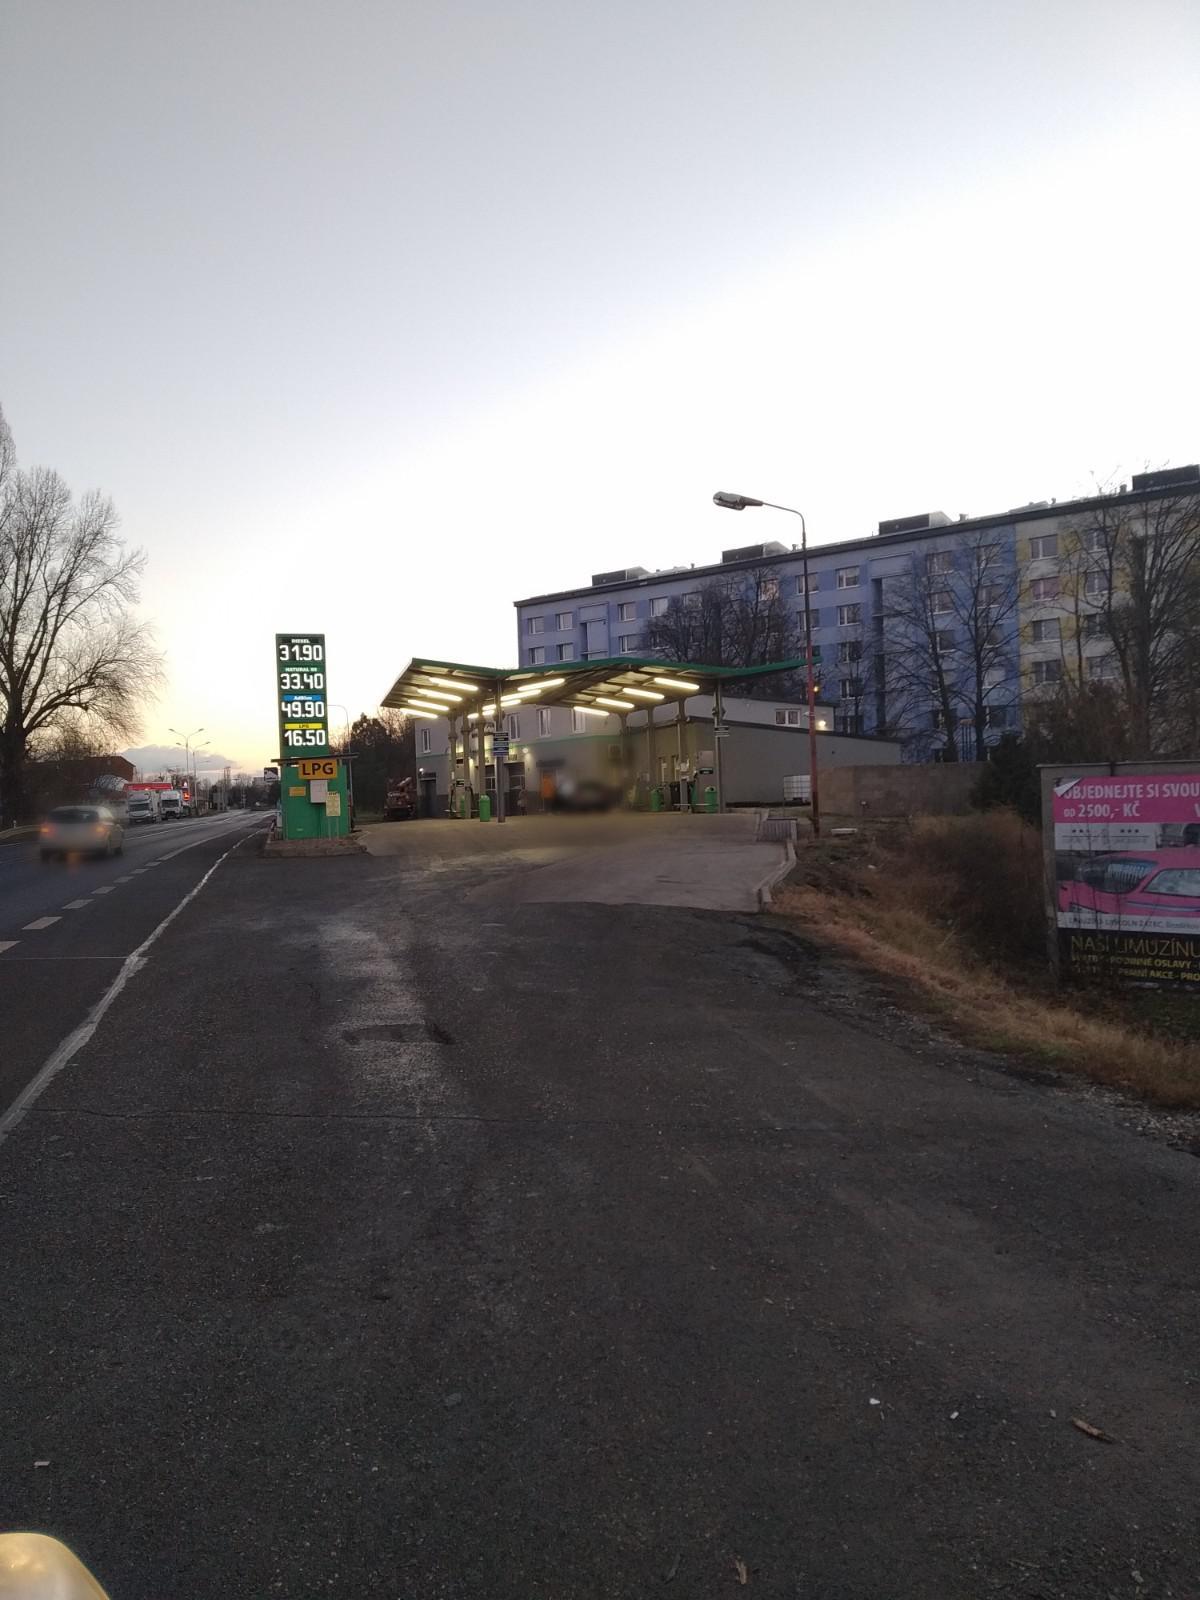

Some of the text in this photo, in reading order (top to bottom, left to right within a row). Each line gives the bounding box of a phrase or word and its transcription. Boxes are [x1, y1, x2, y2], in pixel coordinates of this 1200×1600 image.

[279, 644, 322, 661] 31.90
[280, 673, 324, 689] 33.40
[281, 702, 325, 718] 49.90
[284, 730, 326, 746] 16.50
[302, 762, 334, 776] LPG
[1146, 783, 1159, 798] SI
[1162, 782, 1200, 798] SVOU
[1123, 800, 1140, 817] KČ
[1154, 958, 1192, 969] OSLAVY
